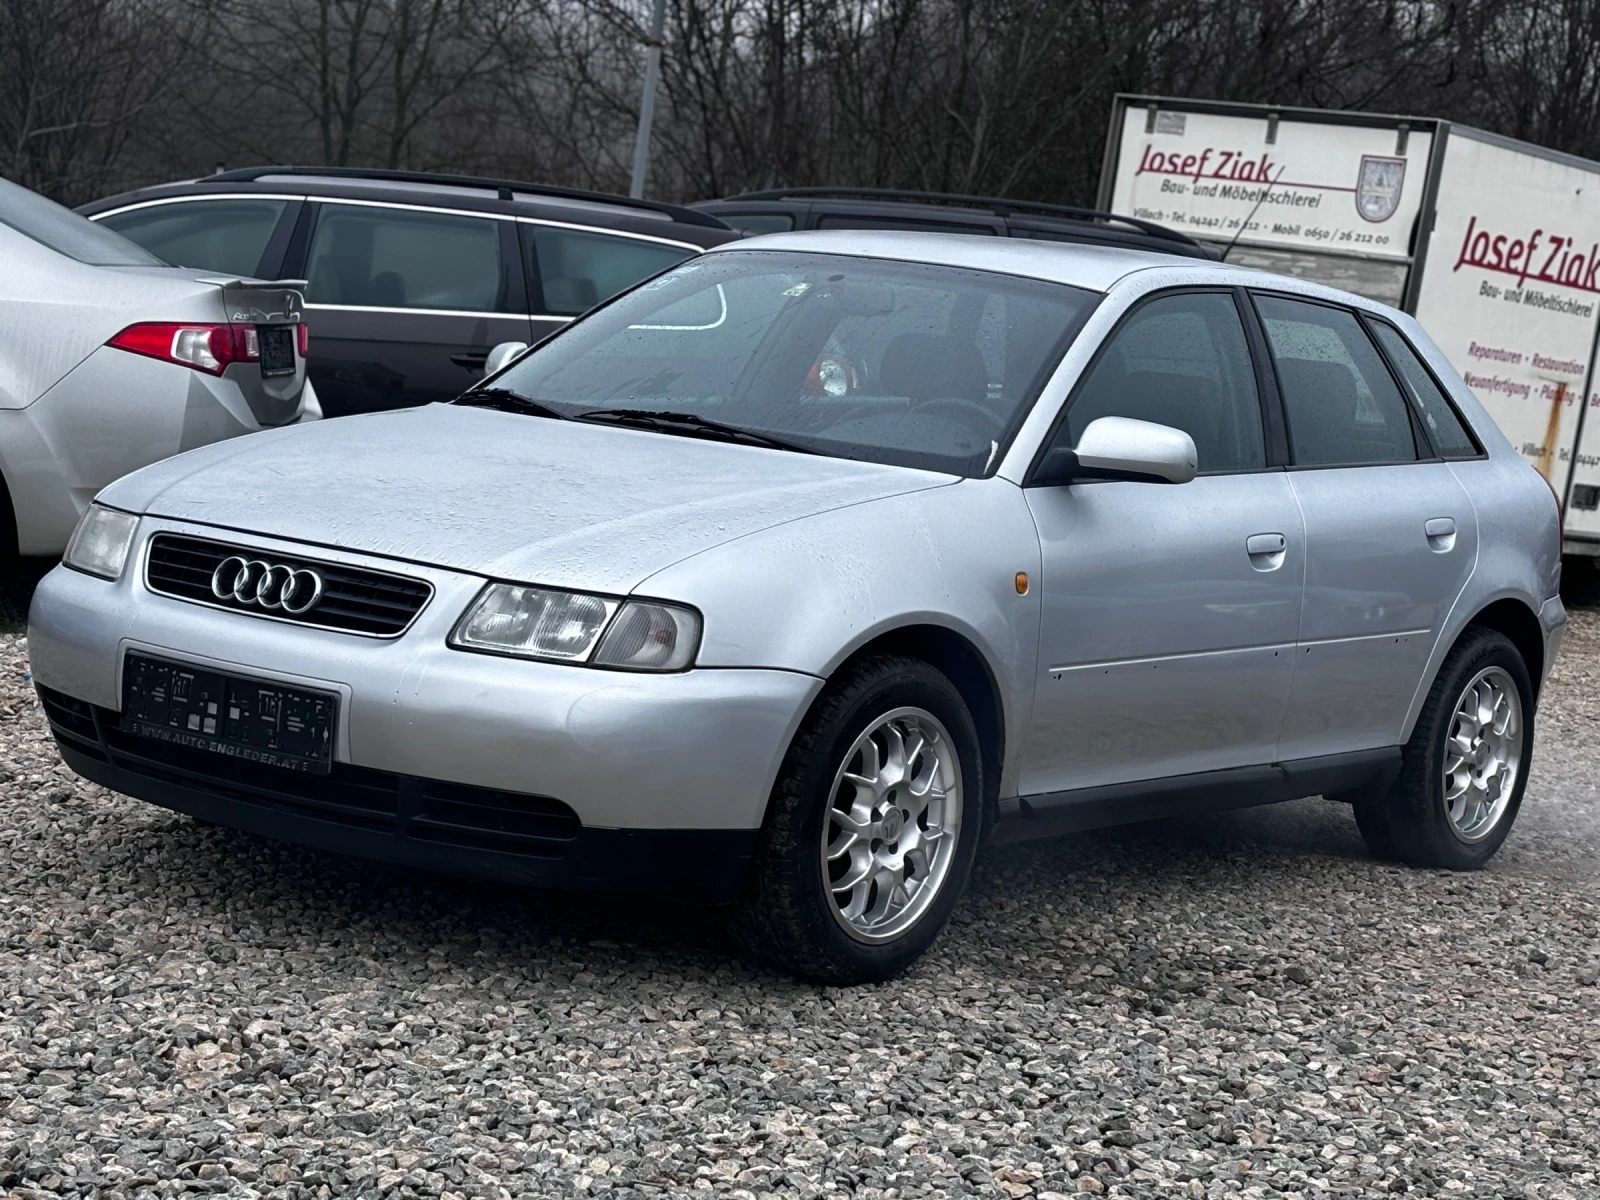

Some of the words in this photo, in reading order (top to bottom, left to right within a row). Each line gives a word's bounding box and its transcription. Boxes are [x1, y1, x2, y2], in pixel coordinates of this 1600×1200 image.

[1135, 144, 1213, 184] Josef
[1212, 151, 1275, 183] Ziak
[1160, 178, 1190, 194] Bau-
[1193, 183, 1218, 197] und
[1219, 184, 1322, 209] Möbeltischlerei
[1133, 207, 1164, 220] Villach
[1171, 211, 1186, 223] Tel.
[1189, 215, 1219, 228] 04242
[1228, 218, 1240, 228] 26
[1271, 223, 1301, 236] Mobil
[1304, 226, 1330, 240] 0650
[1339, 230, 1353, 241] 26
[1355, 233, 1373, 243] 212
[1375, 235, 1389, 244] 00
[1453, 216, 1543, 289] Josef
[1479, 280, 1502, 299] Bau-
[1504, 287, 1524, 304] und
[1523, 288, 1594, 318] Möbeltischlerei
[1467, 341, 1522, 364] Reparaturen
[1531, 352, 1585, 375] Restauration
[1463, 371, 1531, 400] Neuanfertigung
